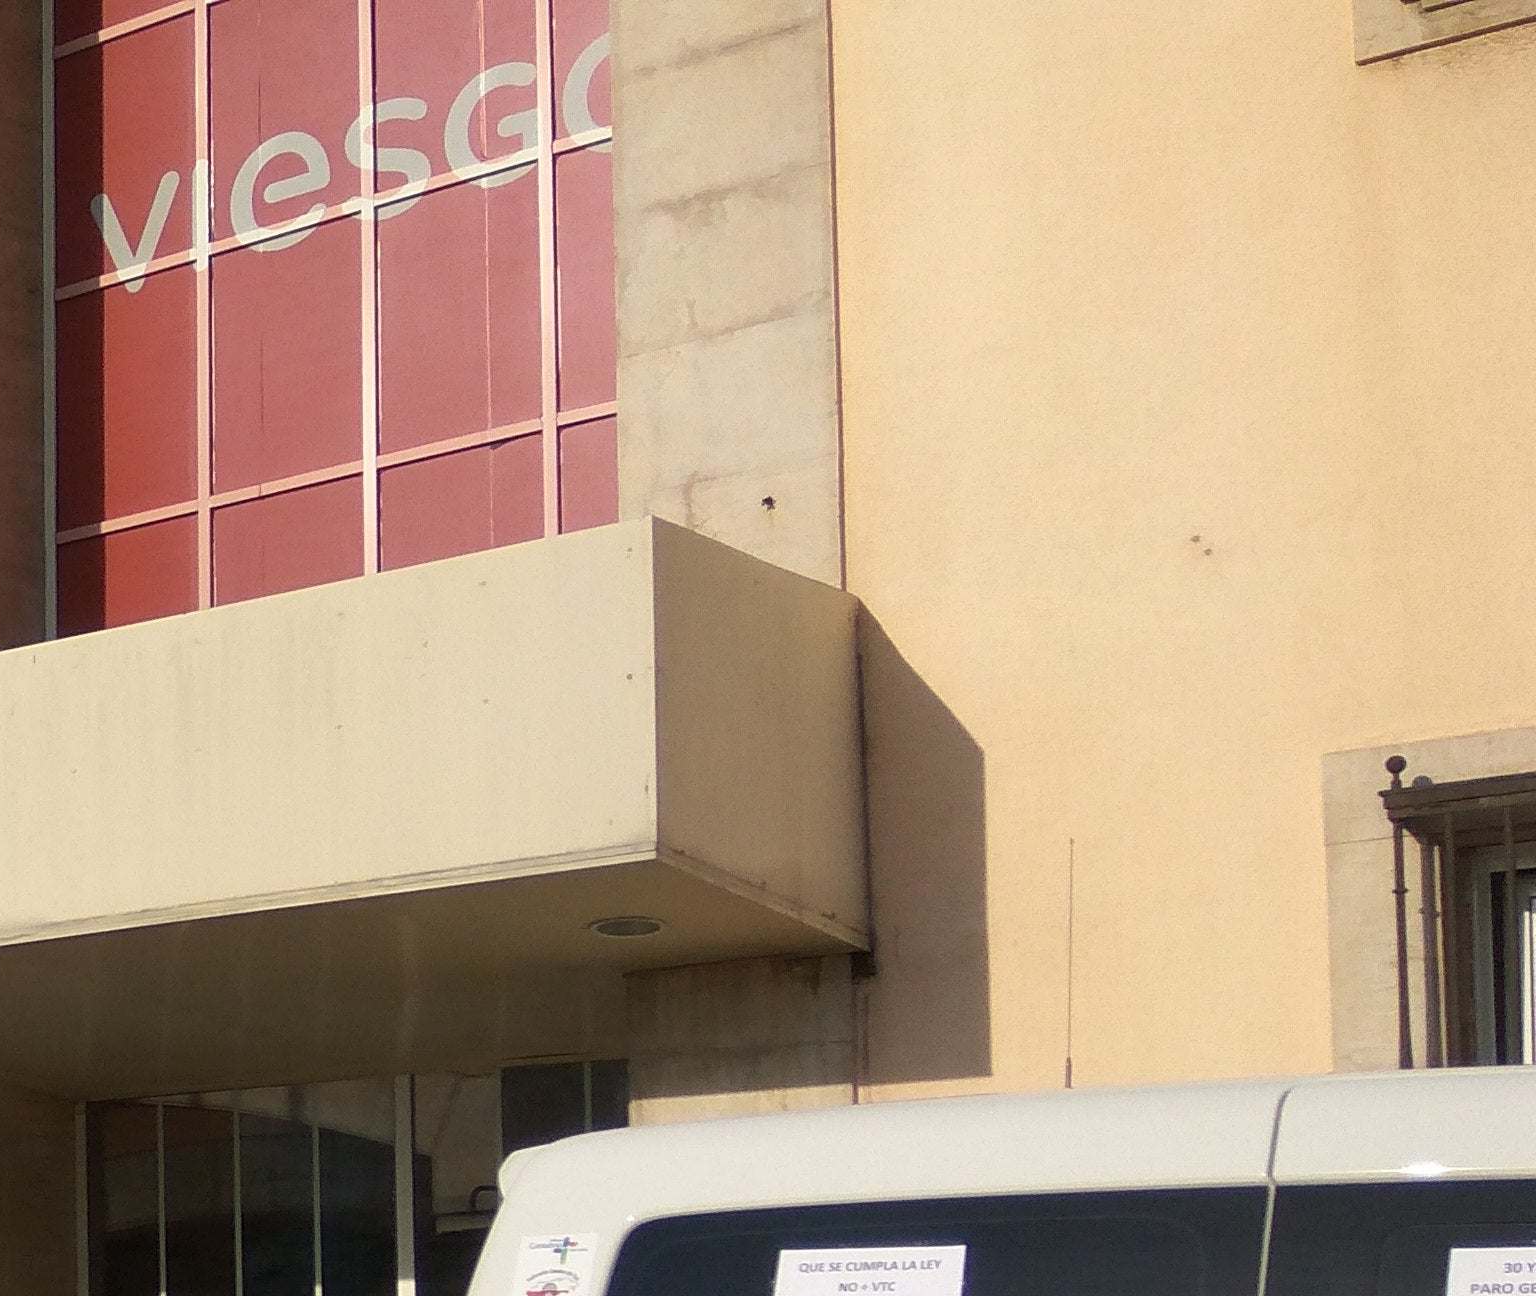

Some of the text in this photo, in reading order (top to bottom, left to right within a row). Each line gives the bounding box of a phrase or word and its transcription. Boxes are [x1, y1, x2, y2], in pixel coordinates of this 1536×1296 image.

[799, 1259, 942, 1274] QUE SE CUMPLA LA LEY
[1503, 1262, 1522, 1273] 30
[838, 1282, 858, 1292] NO
[871, 1281, 897, 1292] VTC
[1470, 1283, 1513, 1294] PARO
